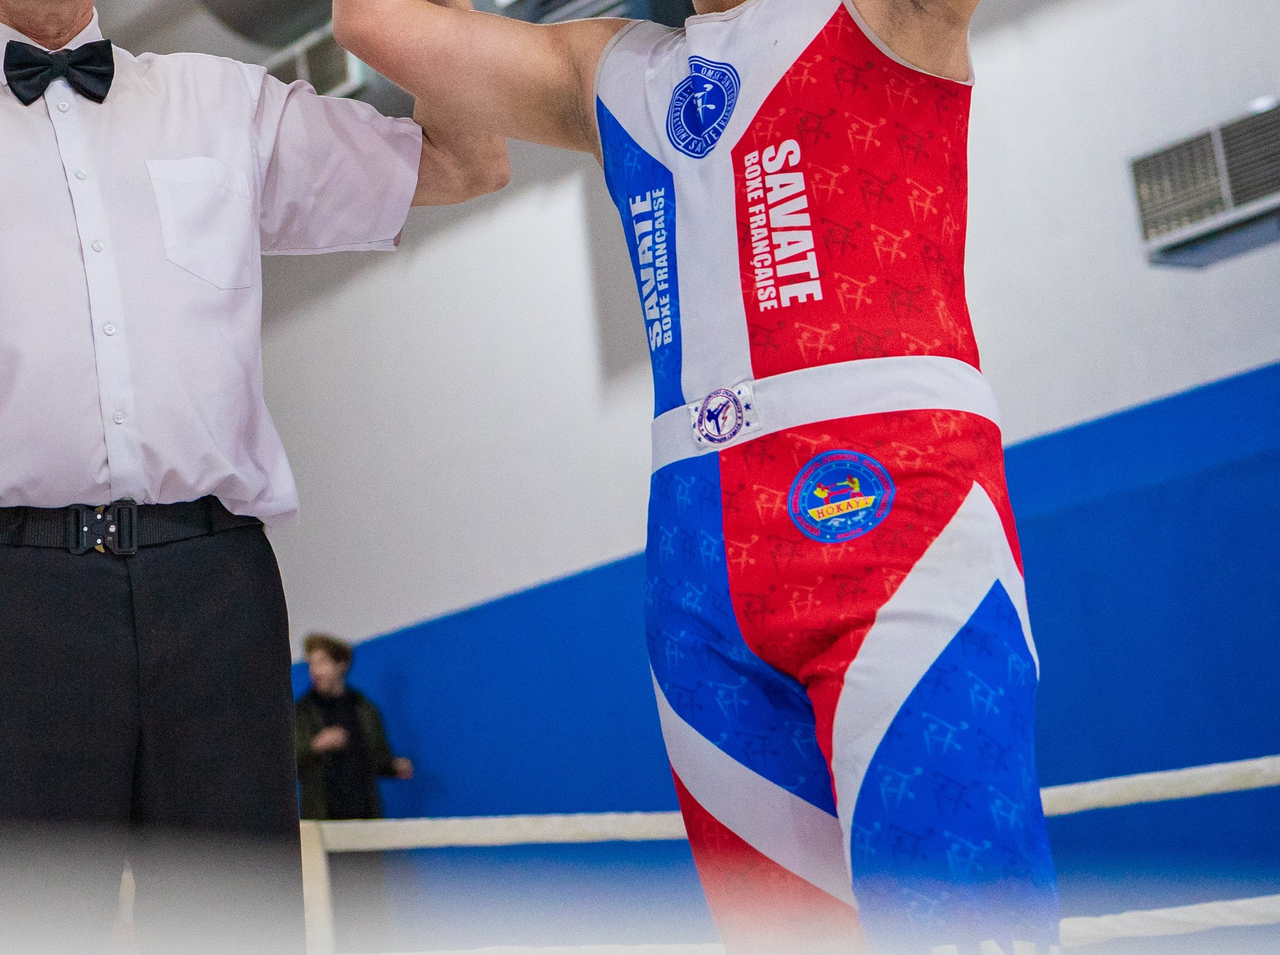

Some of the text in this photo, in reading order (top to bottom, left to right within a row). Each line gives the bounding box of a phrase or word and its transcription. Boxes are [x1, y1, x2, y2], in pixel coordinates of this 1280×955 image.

[672, 90, 689, 140] FEDERATION
[629, 191, 662, 352] SAVATE
[652, 187, 673, 345] BOXE FRANÇAISE
[744, 150, 778, 312] BOXE FRANÇAISE
[762, 139, 823, 307] SAVATE
[816, 496, 870, 519] НОКАУТ
